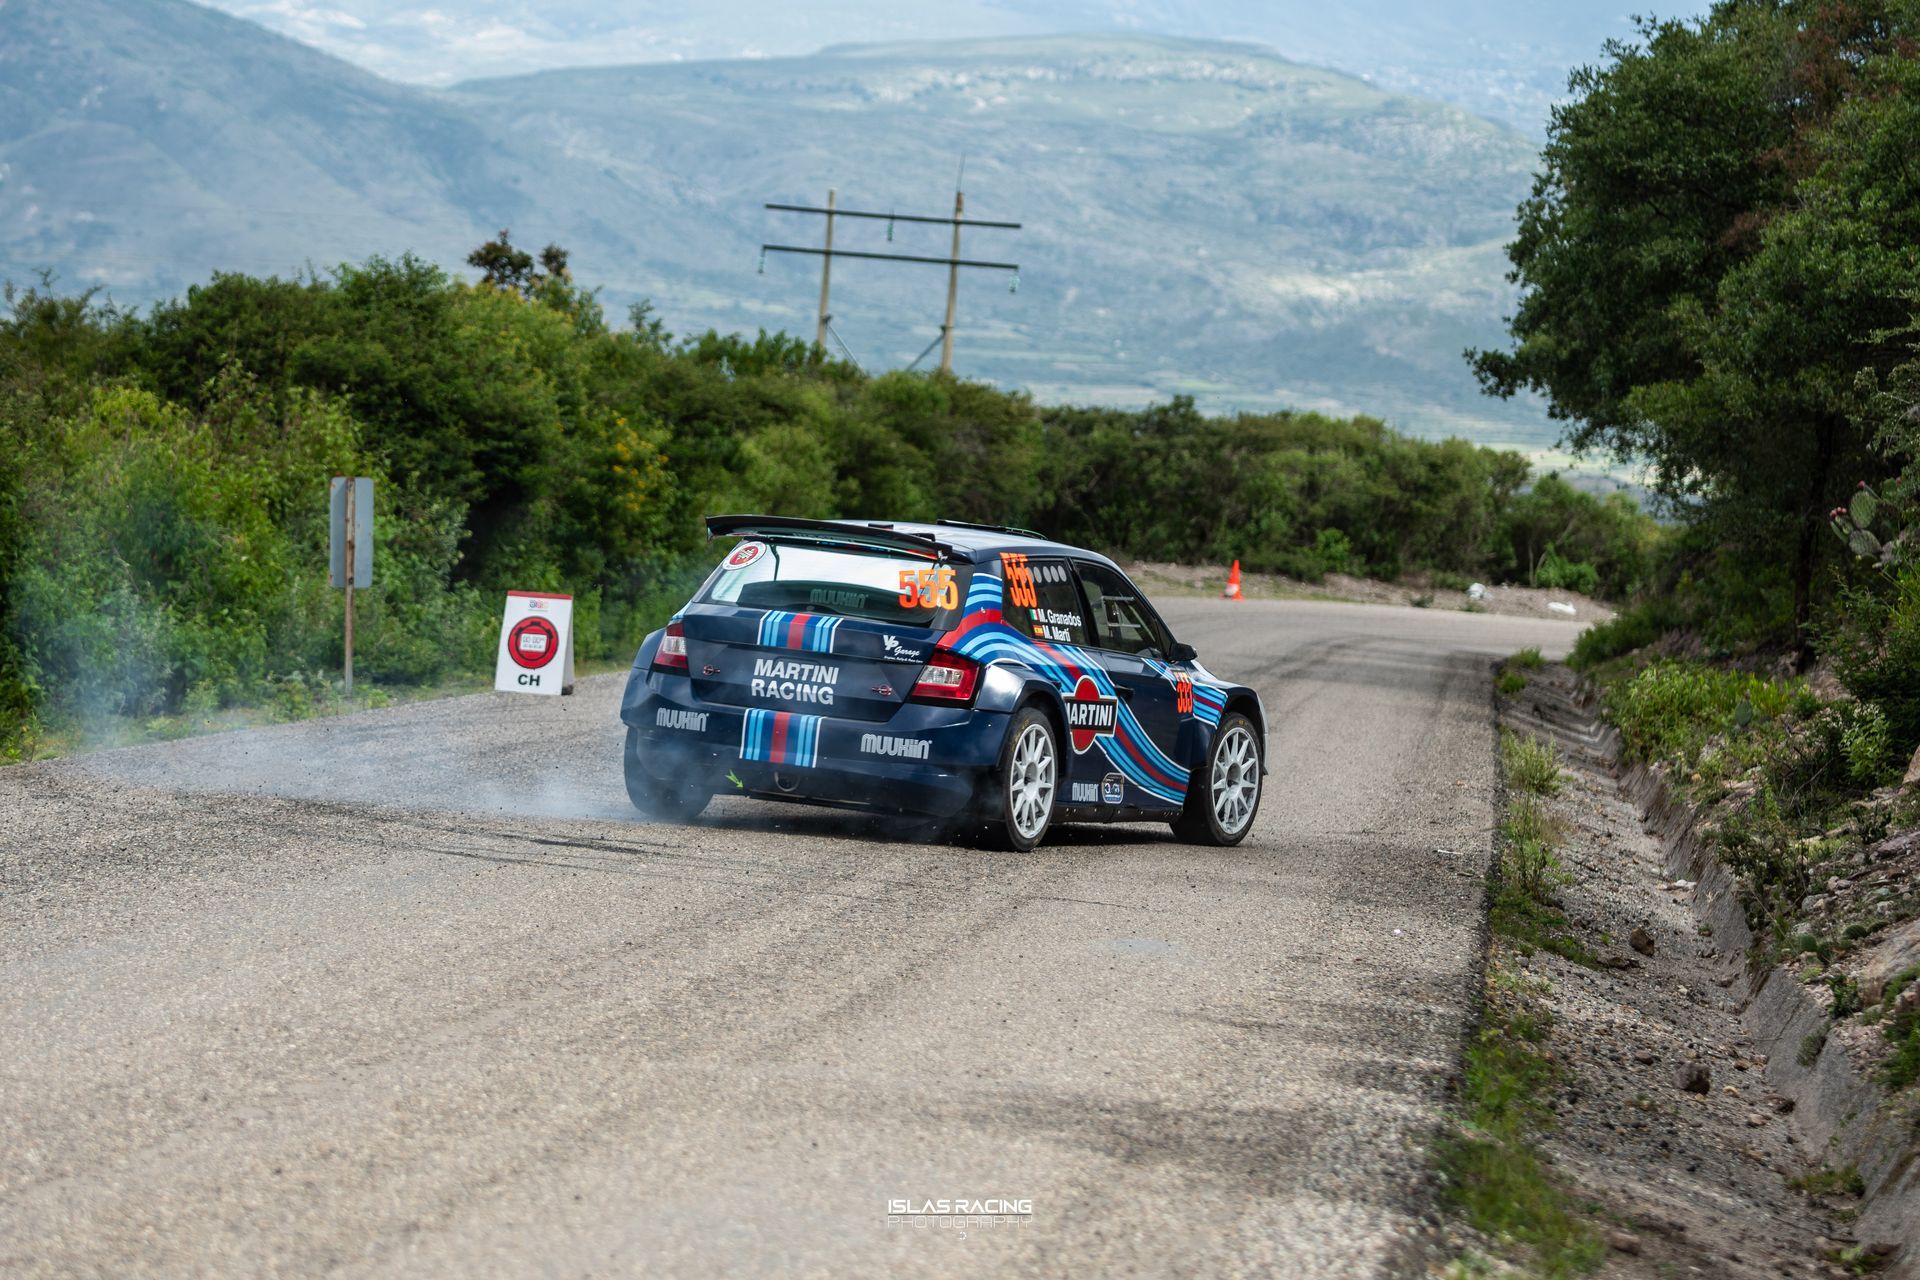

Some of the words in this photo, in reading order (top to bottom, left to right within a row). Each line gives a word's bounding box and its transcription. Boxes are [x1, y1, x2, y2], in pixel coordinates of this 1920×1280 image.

[898, 569, 959, 610] 555
[999, 552, 1037, 608] 555
[1038, 608, 1048, 623] M.
[1047, 609, 1082, 627] Granados
[1042, 624, 1053, 640] M.
[894, 645, 921, 658] Garage
[517, 673, 541, 687] CH
[753, 658, 840, 685] MARTINI
[751, 678, 835, 706] RACING
